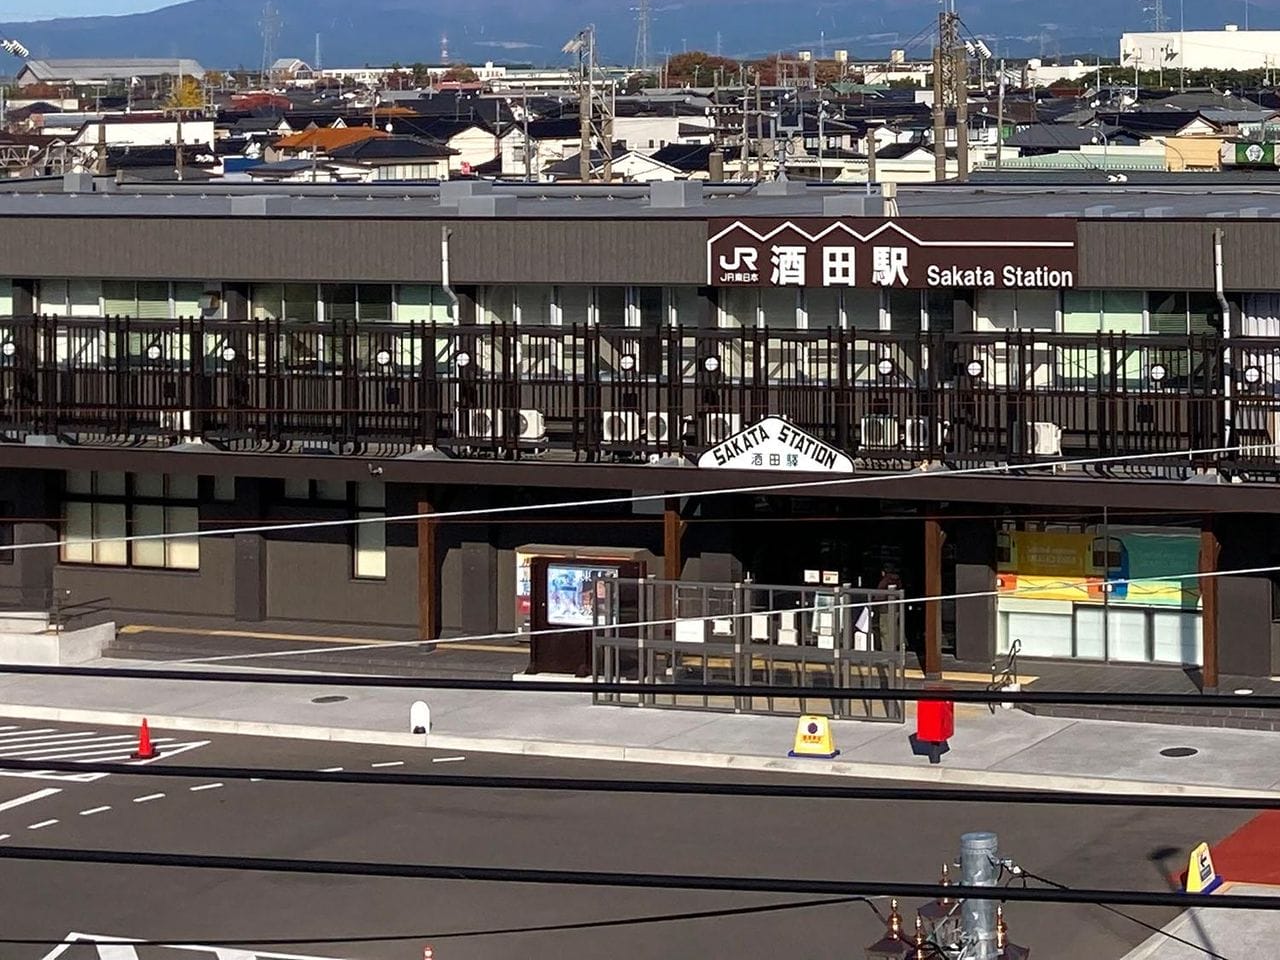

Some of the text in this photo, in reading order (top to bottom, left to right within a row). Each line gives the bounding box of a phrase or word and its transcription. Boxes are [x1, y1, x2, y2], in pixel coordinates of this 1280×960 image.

[719, 247, 758, 271] JR
[770, 245, 909, 287] 酒田駅
[720, 272, 759, 283] JR東日本
[927, 265, 1073, 288] Sakata Station
[713, 424, 838, 470] SAKATA STATION
